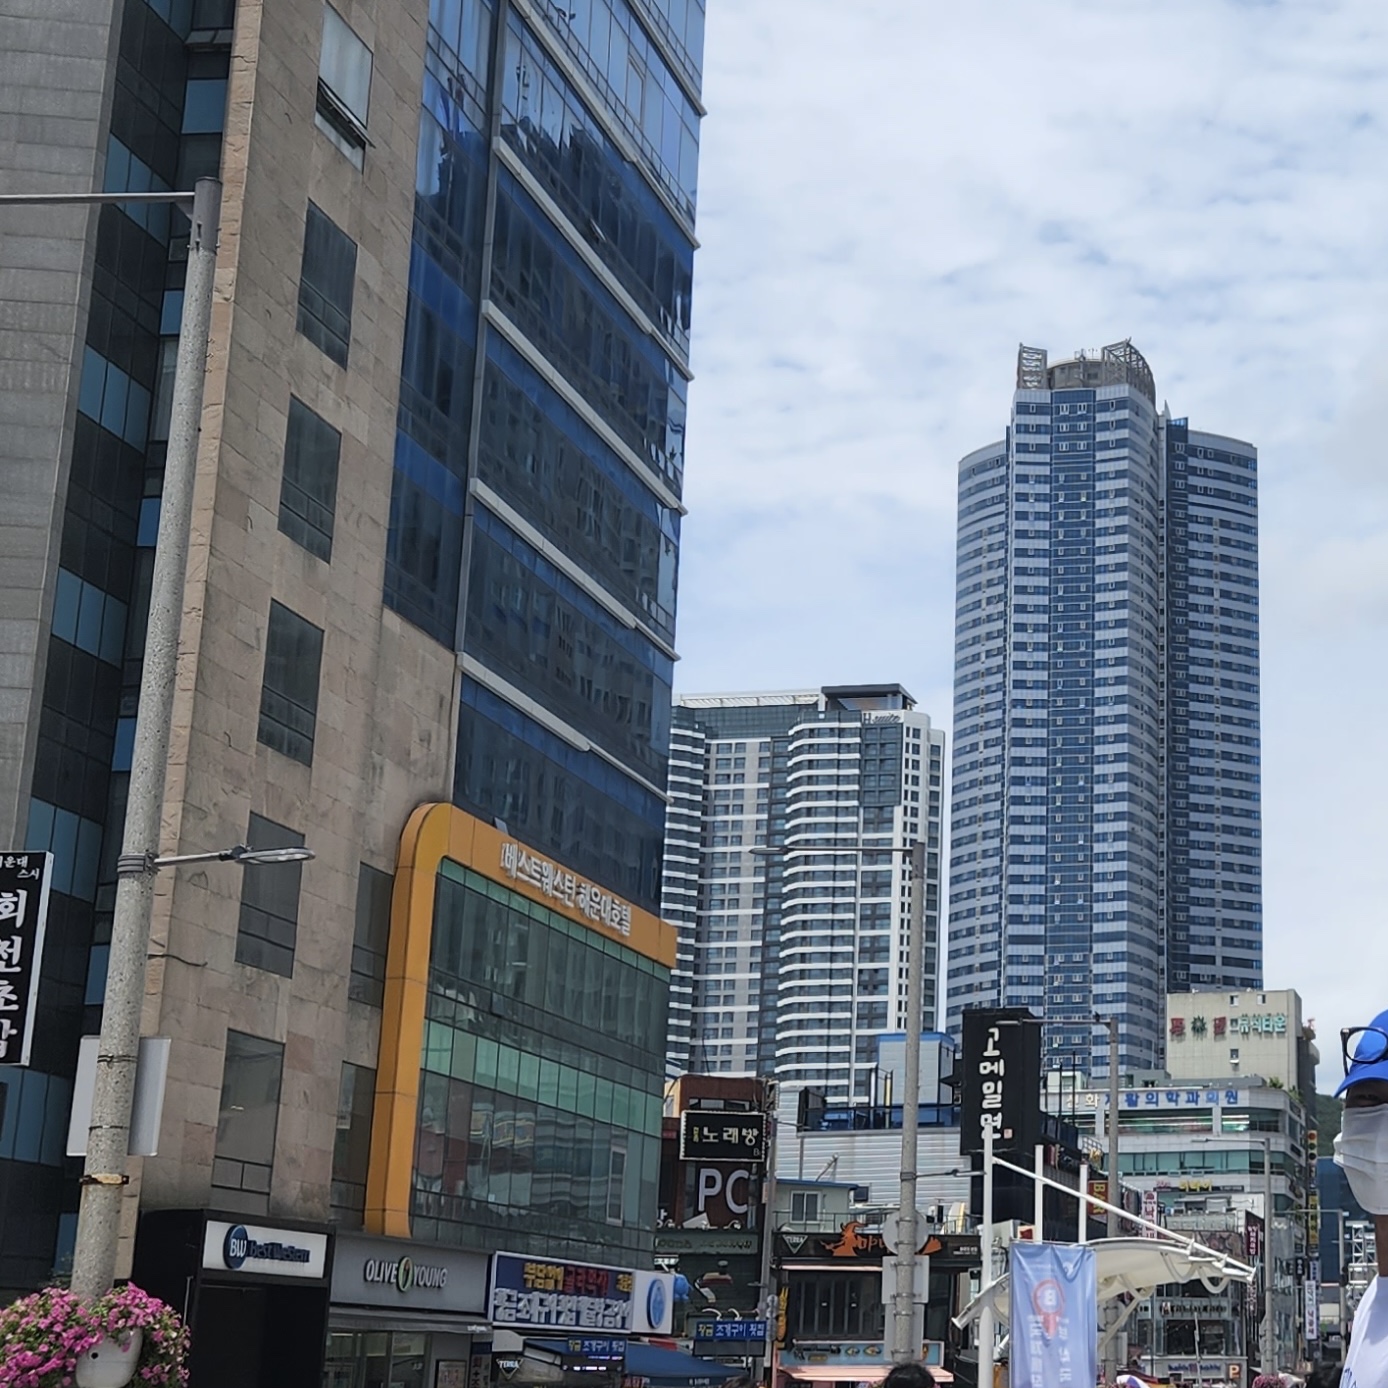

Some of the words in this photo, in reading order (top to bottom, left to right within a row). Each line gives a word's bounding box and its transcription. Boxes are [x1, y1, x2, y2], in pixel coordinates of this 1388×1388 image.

[0, 855, 28, 868] 운대
[17, 868, 40, 880] 스시
[702, 1126, 759, 1146] 노래방
[698, 1168, 750, 1214] PC
[230, 1238, 248, 1257] BW
[366, 1259, 398, 1283] OLIVE
[413, 1266, 448, 1288] YOUNG
